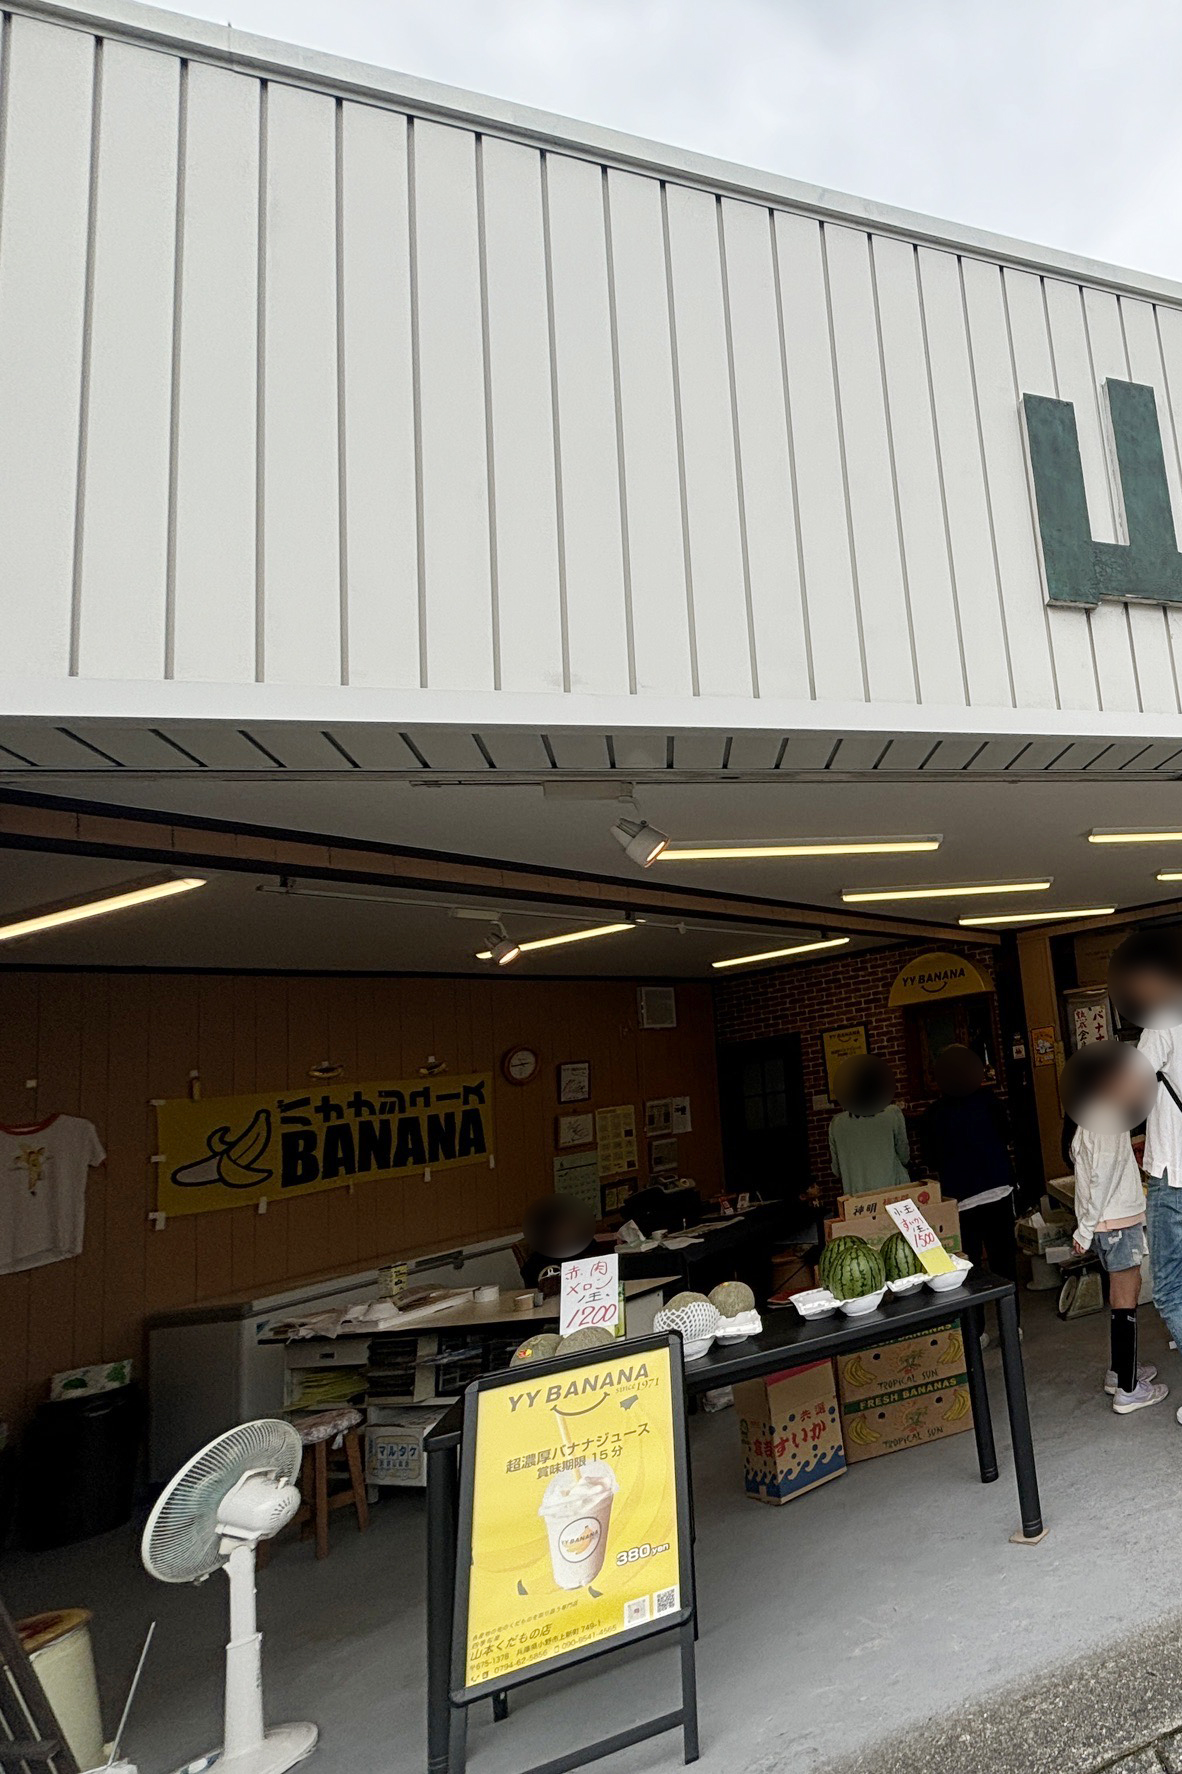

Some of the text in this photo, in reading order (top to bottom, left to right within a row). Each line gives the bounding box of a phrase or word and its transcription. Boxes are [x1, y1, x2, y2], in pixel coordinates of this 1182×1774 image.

[902, 967, 965, 987] YY BANANA
[281, 1107, 486, 1188] BANANA
[853, 1202, 878, 1216] 神明
[914, 1232, 936, 1248] 1500
[565, 1261, 608, 1280] 赤肉
[566, 1276, 613, 1296] メロン
[566, 1303, 617, 1328] 1200
[508, 1363, 649, 1413] YY BANANA
[615, 1377, 660, 1394] since 1971
[877, 1369, 939, 1390] TROPICAL SUN
[859, 1377, 957, 1410] FRESH BANANAS
[505, 1422, 651, 1474] 超濃厚バナナジュース
[882, 1426, 944, 1448] TROPICAL SUN
[536, 1445, 624, 1480] 賞味期限 15分
[569, 1529, 599, 1545] BANANA
[616, 1543, 670, 1566] 380yen
[470, 1623, 553, 1662] 山本くだもの店
